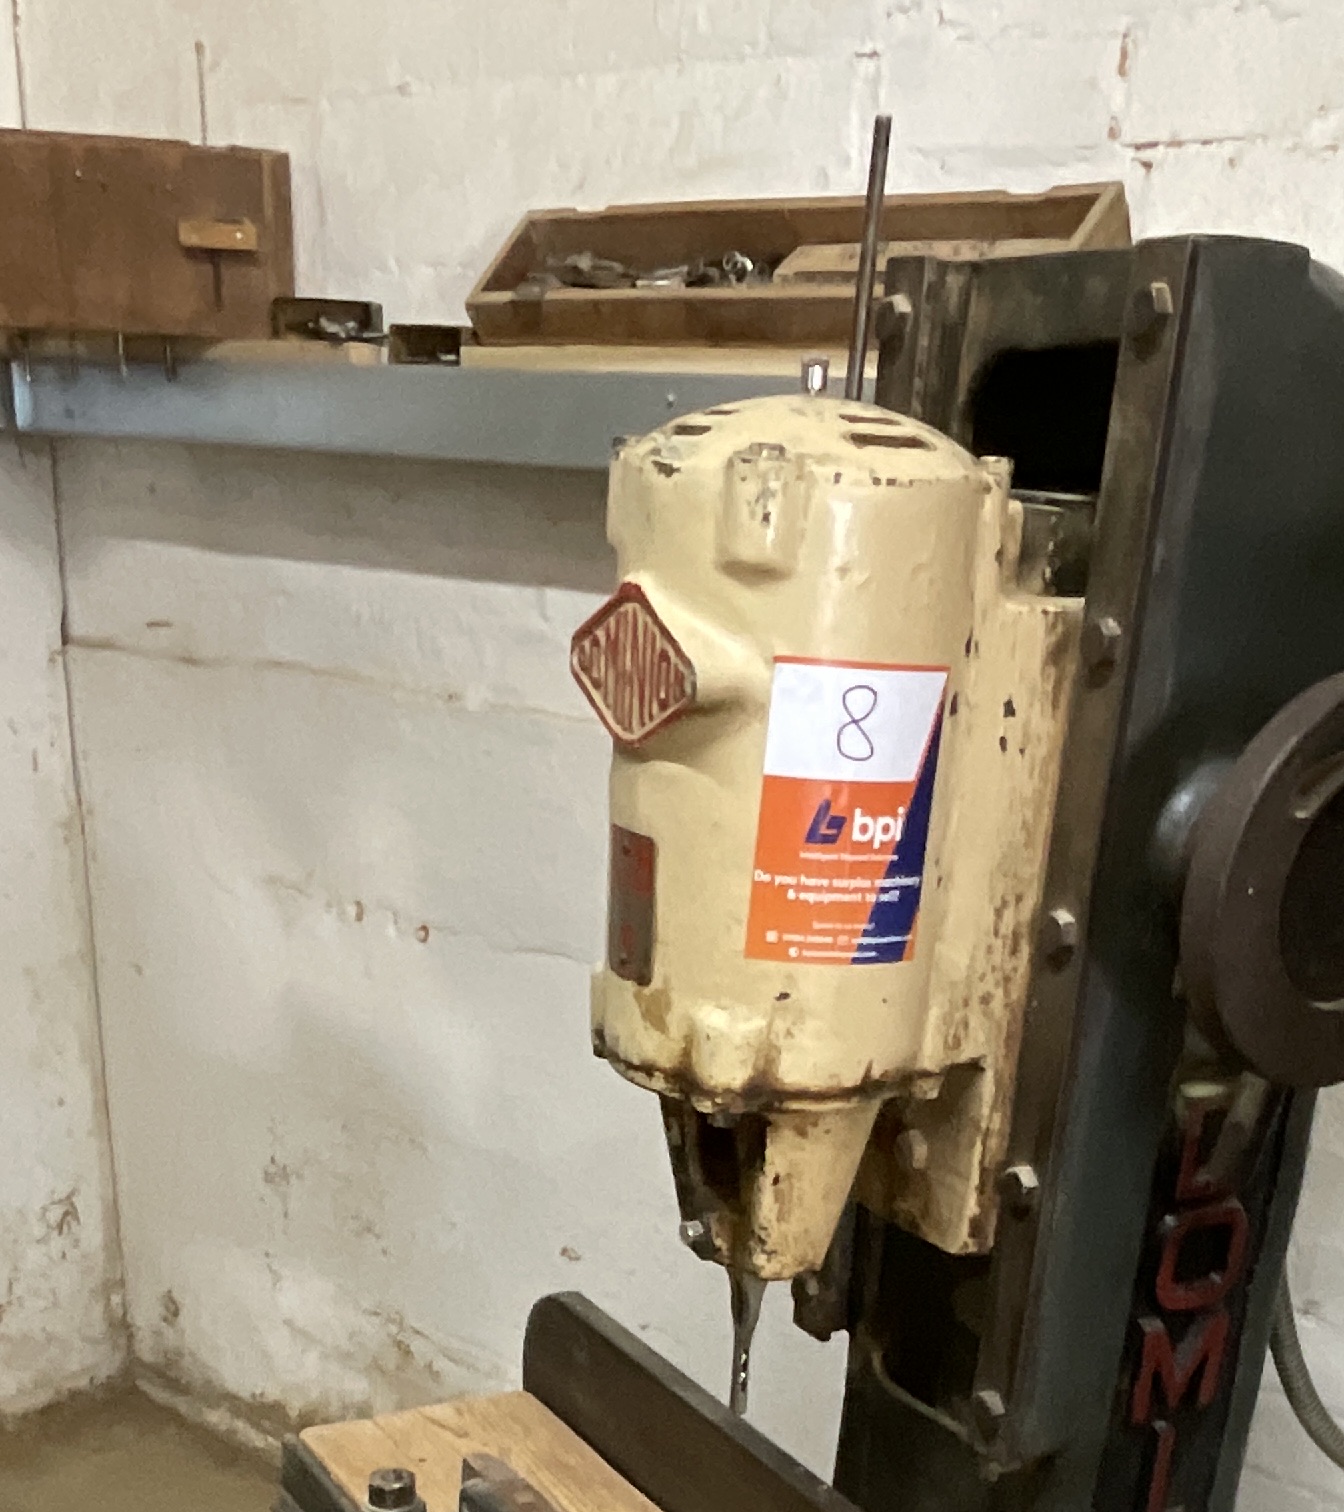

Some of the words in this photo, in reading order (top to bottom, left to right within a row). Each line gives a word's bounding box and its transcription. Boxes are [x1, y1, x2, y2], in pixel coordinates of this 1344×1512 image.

[837, 685, 878, 762] 8
[851, 807, 906, 849] bpi
[774, 875, 797, 888] you
[800, 874, 830, 887] have
